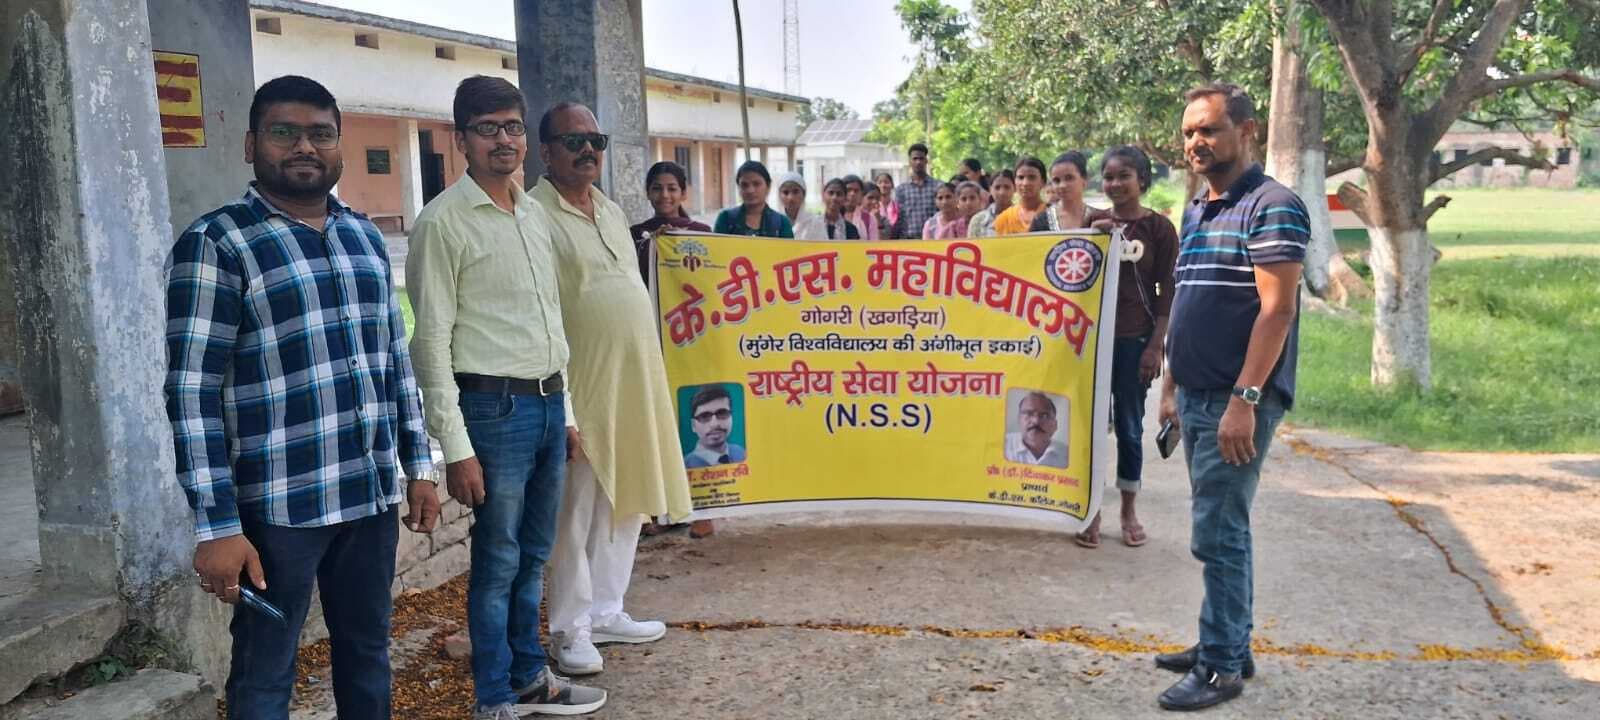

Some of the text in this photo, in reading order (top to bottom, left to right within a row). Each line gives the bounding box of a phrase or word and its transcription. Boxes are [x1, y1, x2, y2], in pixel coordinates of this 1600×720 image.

[866, 242, 1094, 356] महाविद्यालय
[801, 305, 946, 329] गोगरी (खगड़िया)
[739, 333, 1041, 358] (मुंगेर विश्वविद्यालय की अंगीभूत इकाई)
[748, 360, 1004, 405] राष्ट्रीय सेवा योजना
[825, 403, 931, 434] (N.S.S)
